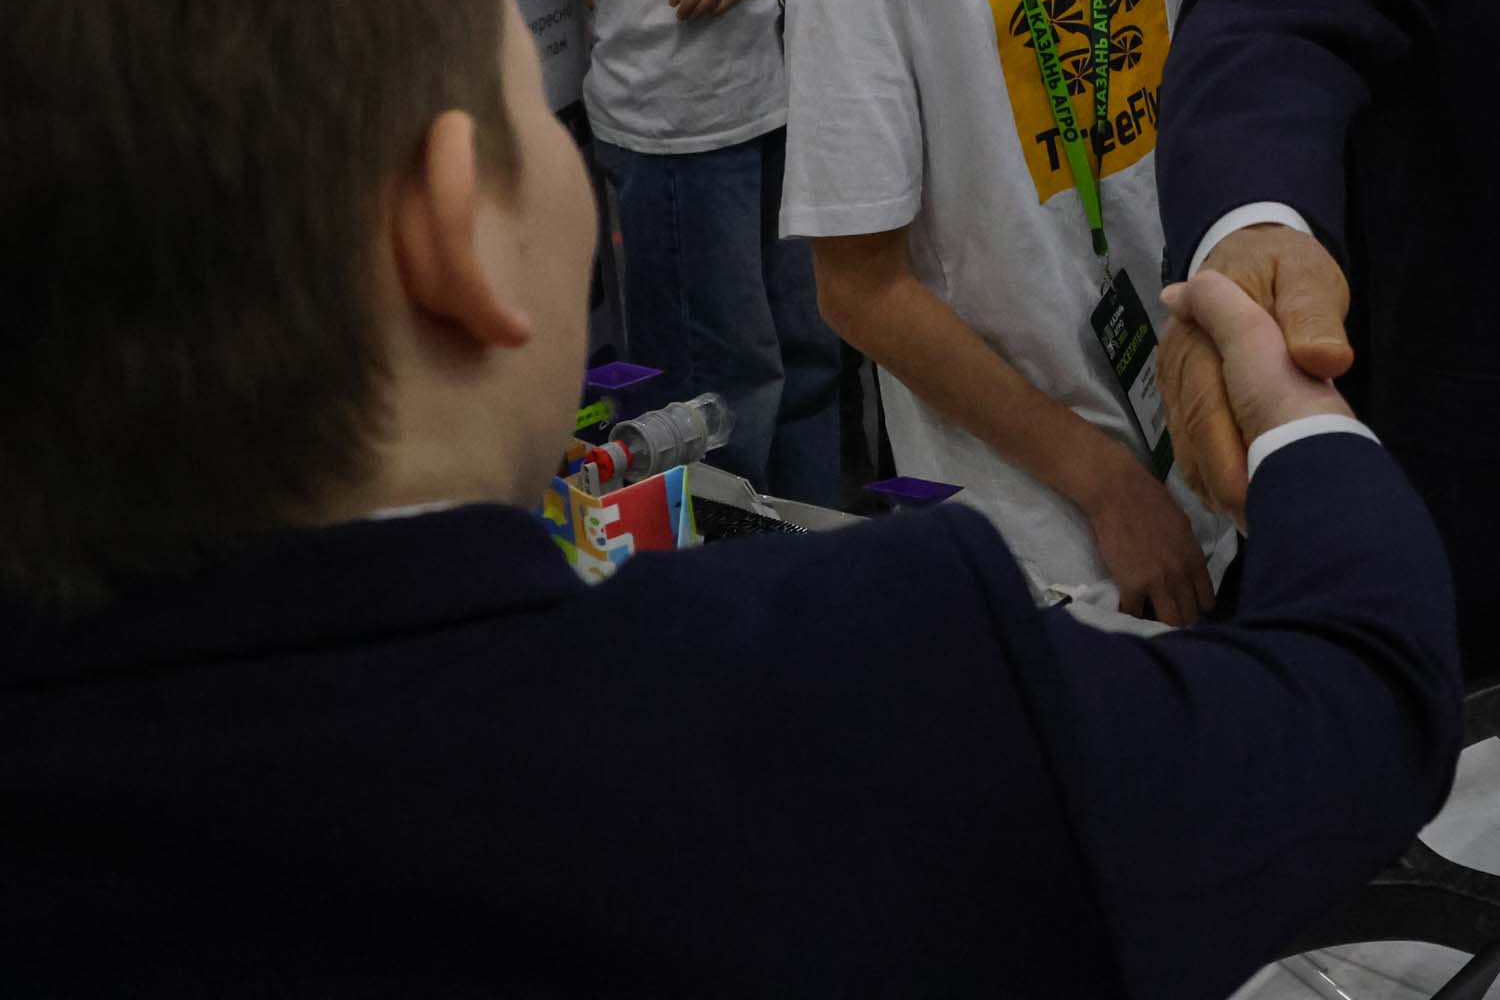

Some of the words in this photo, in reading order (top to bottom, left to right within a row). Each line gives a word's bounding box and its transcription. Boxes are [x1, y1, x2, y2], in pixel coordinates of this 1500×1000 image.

[1030, 11, 1064, 91] КАЗАНЬ
[1051, 94, 1080, 143] АГРО
[1096, 34, 1110, 118] КАЗАНЬ
